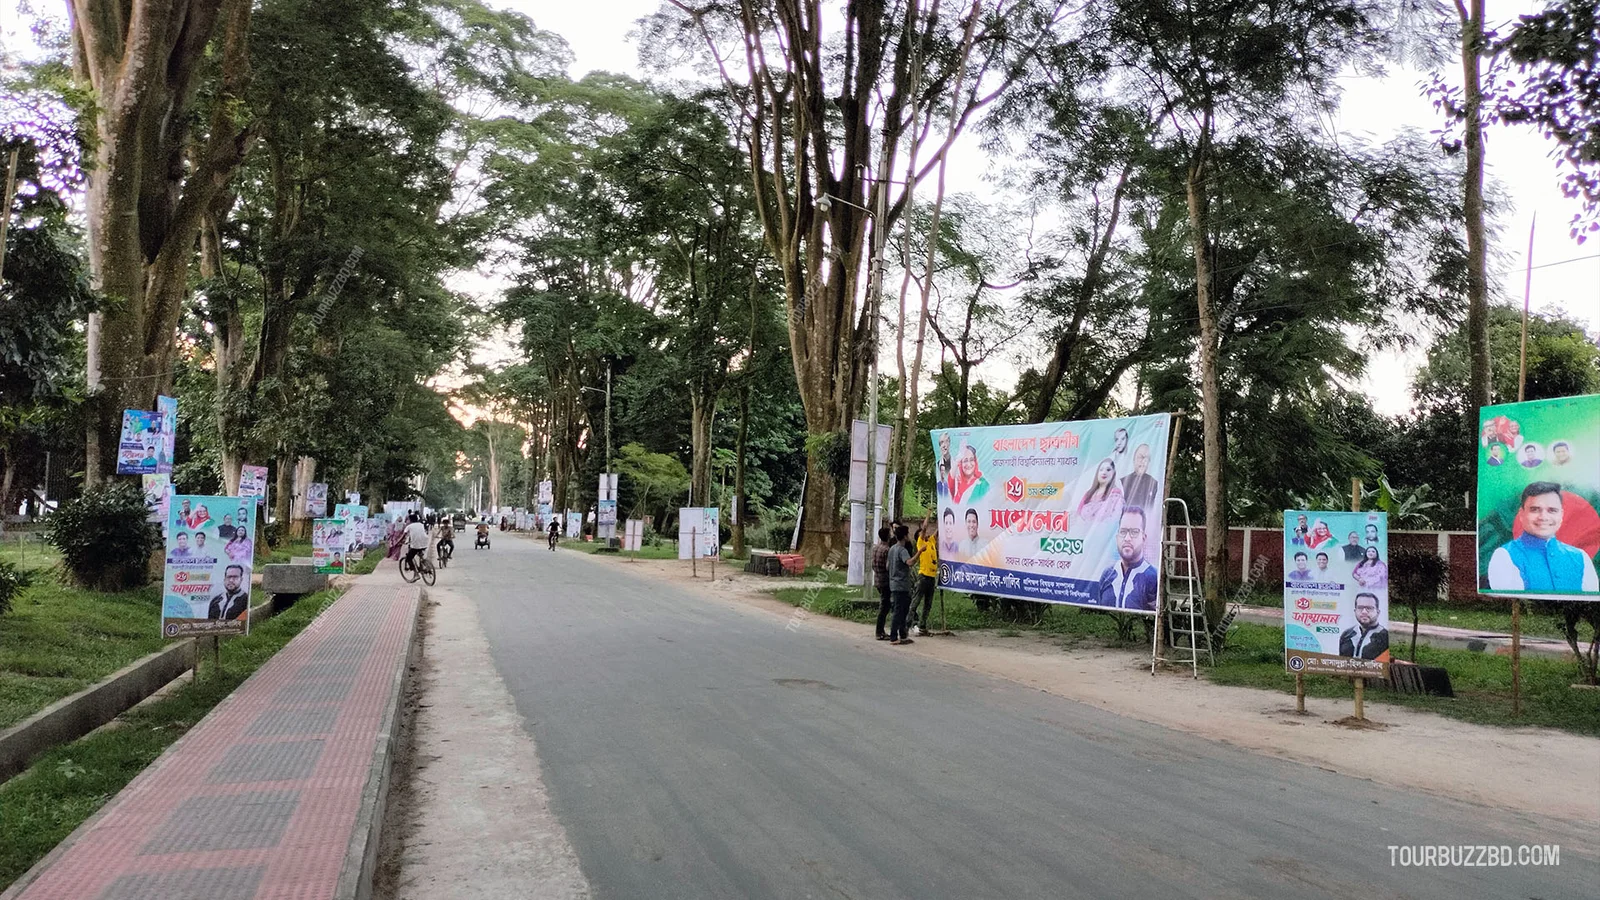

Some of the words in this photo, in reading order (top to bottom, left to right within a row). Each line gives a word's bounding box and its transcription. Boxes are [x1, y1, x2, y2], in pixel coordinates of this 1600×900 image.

[992, 437, 1037, 452] বাংলাদেশ
[1040, 430, 1079, 453] ছাত্রলীগ
[1007, 481, 1022, 497] ২৬
[988, 508, 1069, 534] সম্মেলন
[1045, 537, 1083, 554] ২০২৩
[1297, 599, 1309, 608] ২৬
